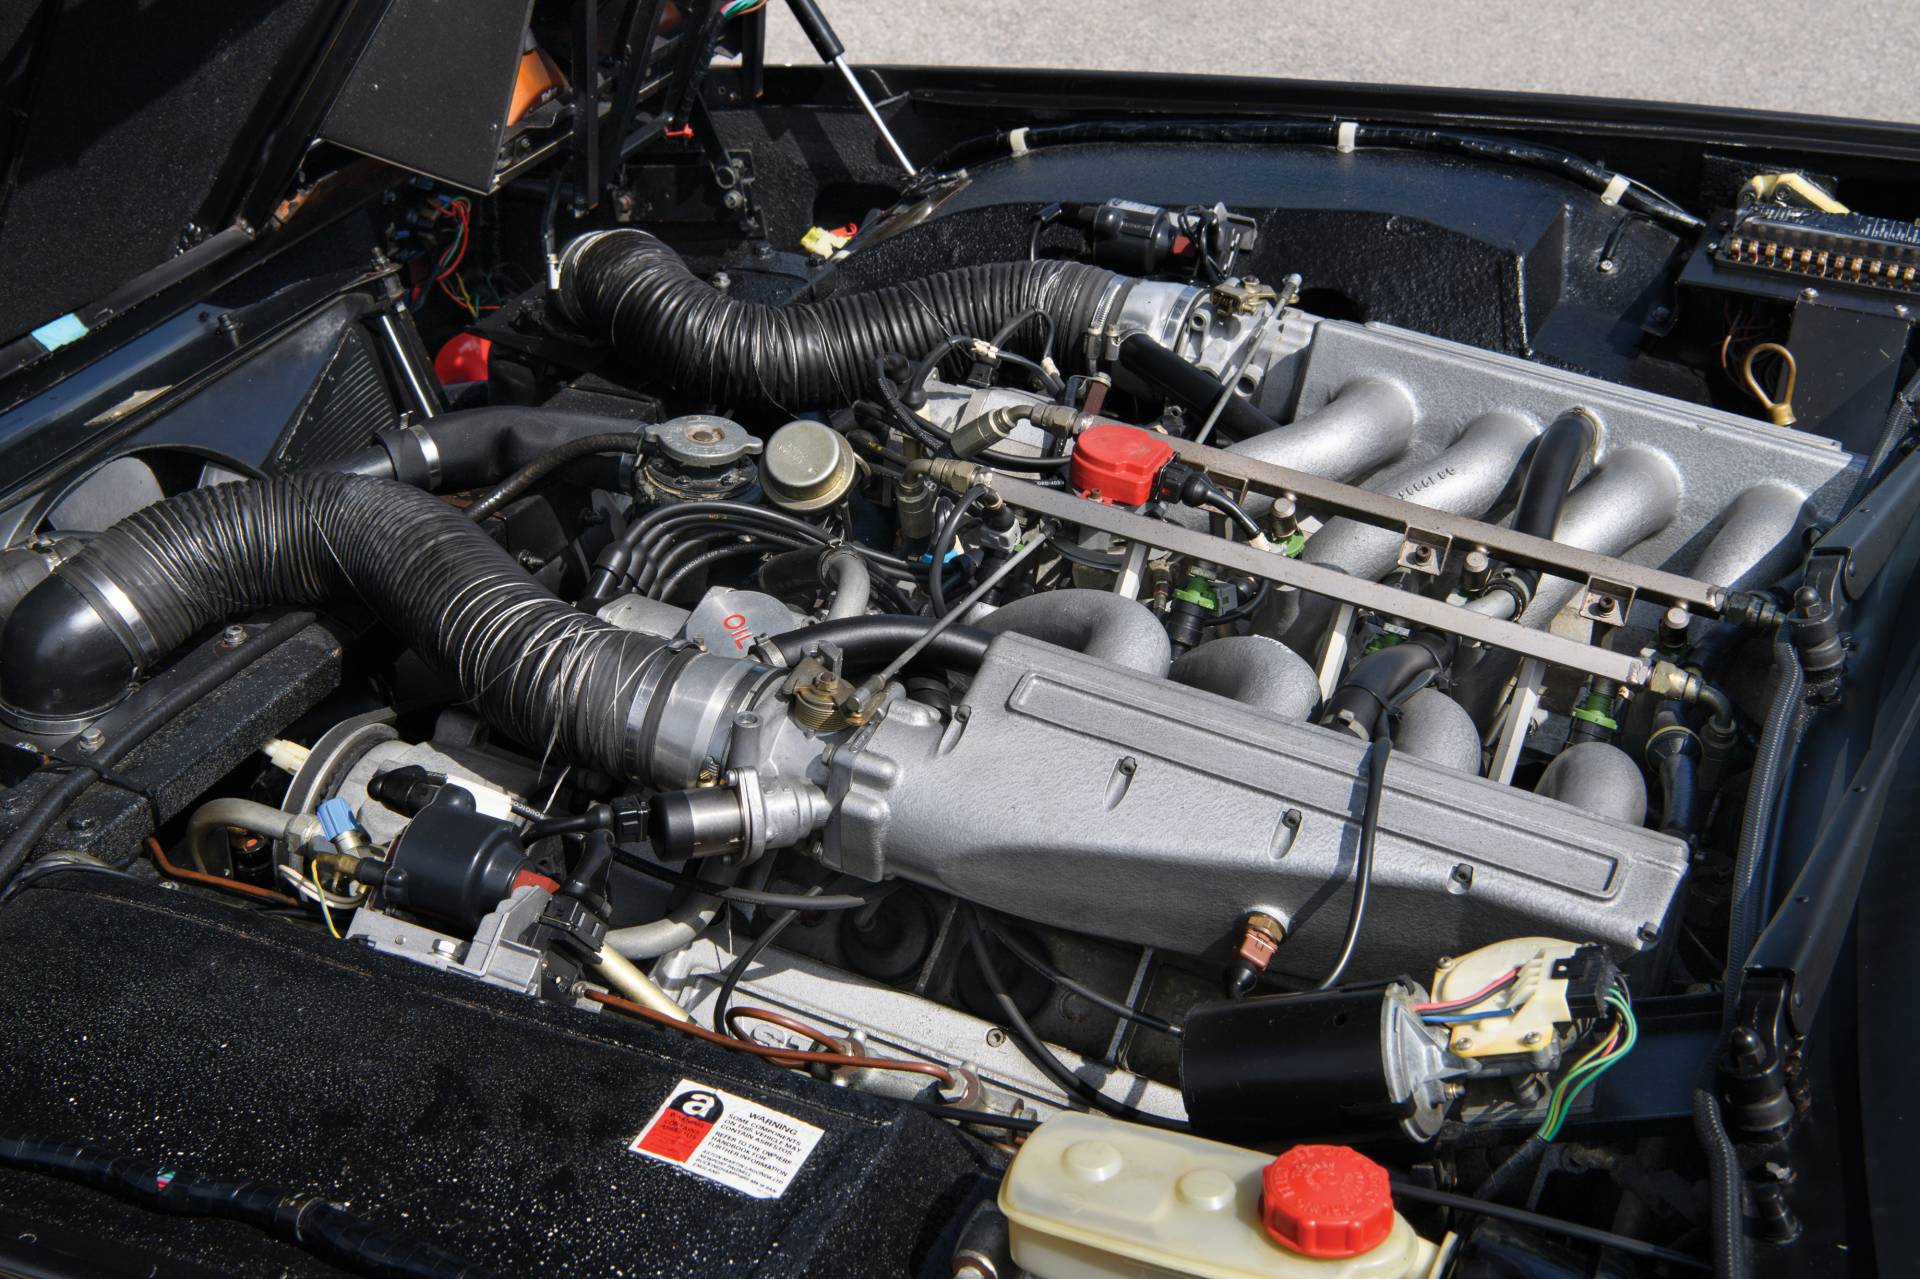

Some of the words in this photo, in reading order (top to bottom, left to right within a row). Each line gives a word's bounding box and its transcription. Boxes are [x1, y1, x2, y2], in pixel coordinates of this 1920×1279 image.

[722, 613, 753, 651] OIL
[682, 1093, 715, 1119] a
[716, 1131, 736, 1142] REFER
[720, 1124, 753, 1139] CONTAIN
[728, 1114, 748, 1124] SOME
[751, 1122, 801, 1146] COMPONENTS
[749, 1112, 798, 1135] WARNING
[712, 1137, 750, 1154] HANDBOOK
[752, 1152, 767, 1161] FOR
[738, 1124, 753, 1133] THIS
[755, 1130, 782, 1145] VEHICLE
[785, 1143, 801, 1153] MAY
[708, 1142, 739, 1157] FURTHER
[740, 1154, 787, 1176] INFORMATION
